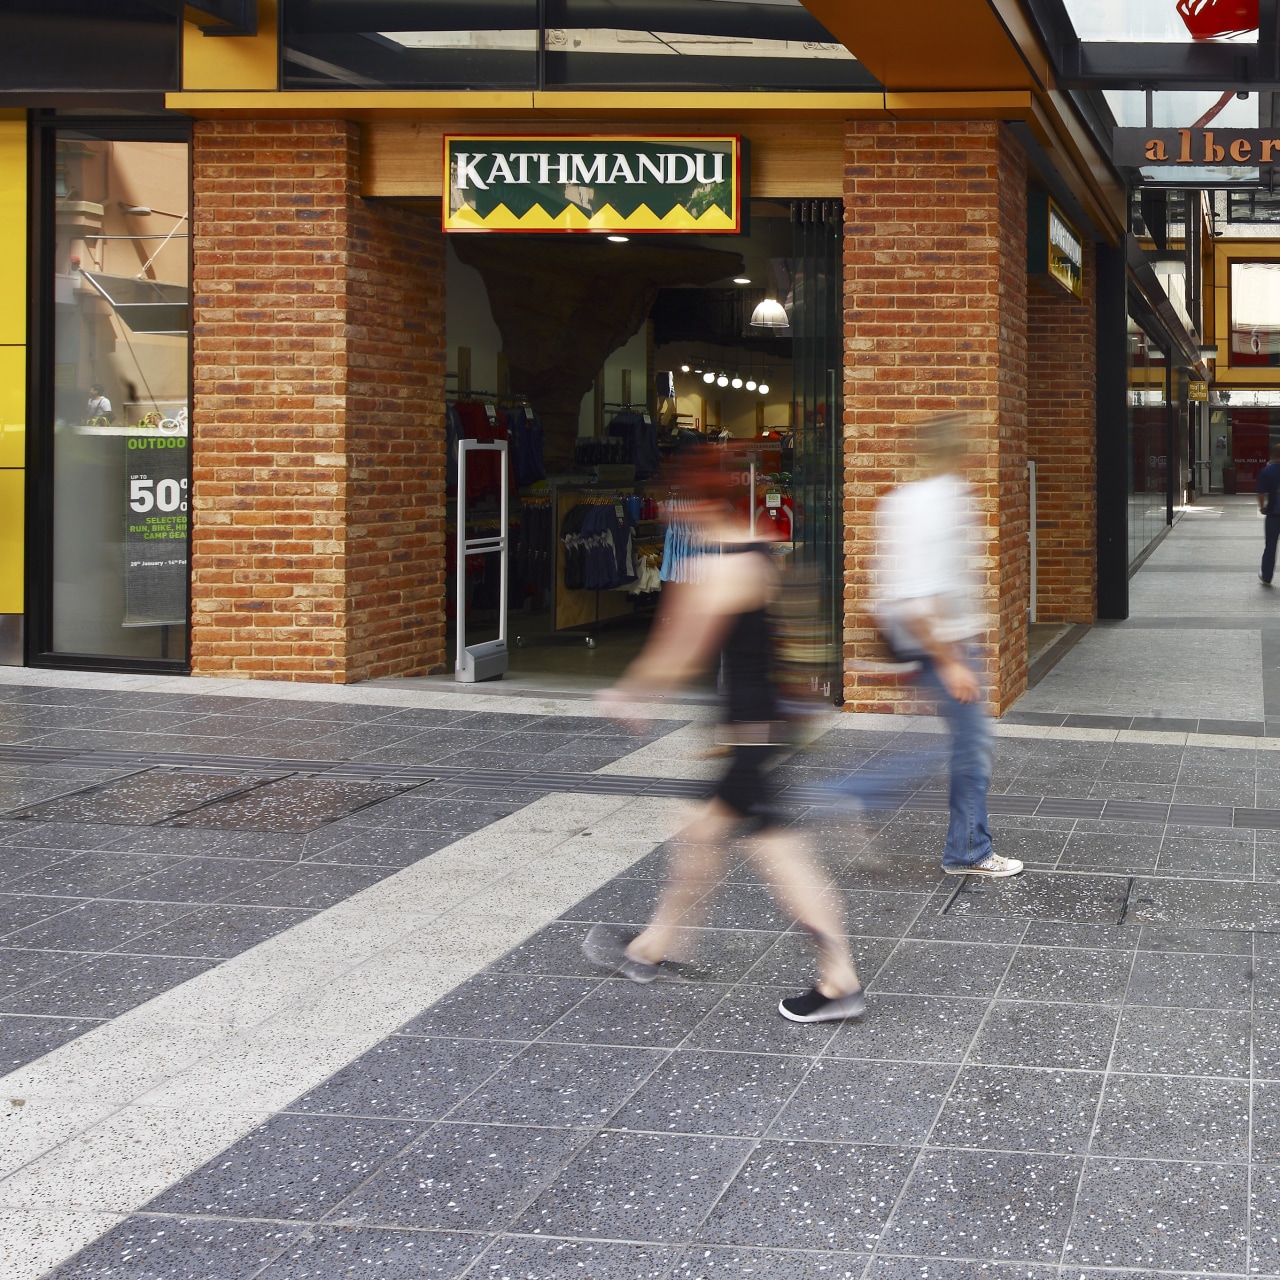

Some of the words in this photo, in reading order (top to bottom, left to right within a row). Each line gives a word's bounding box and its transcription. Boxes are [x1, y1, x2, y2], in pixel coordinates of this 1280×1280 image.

[454, 152, 726, 190] KATHMANDU
[146, 516, 188, 524] SELECTED
[130, 525, 150, 533] RUN,
[152, 524, 174, 532] BIKE,
[143, 532, 168, 540] CAMP
[169, 531, 187, 539] GEA
